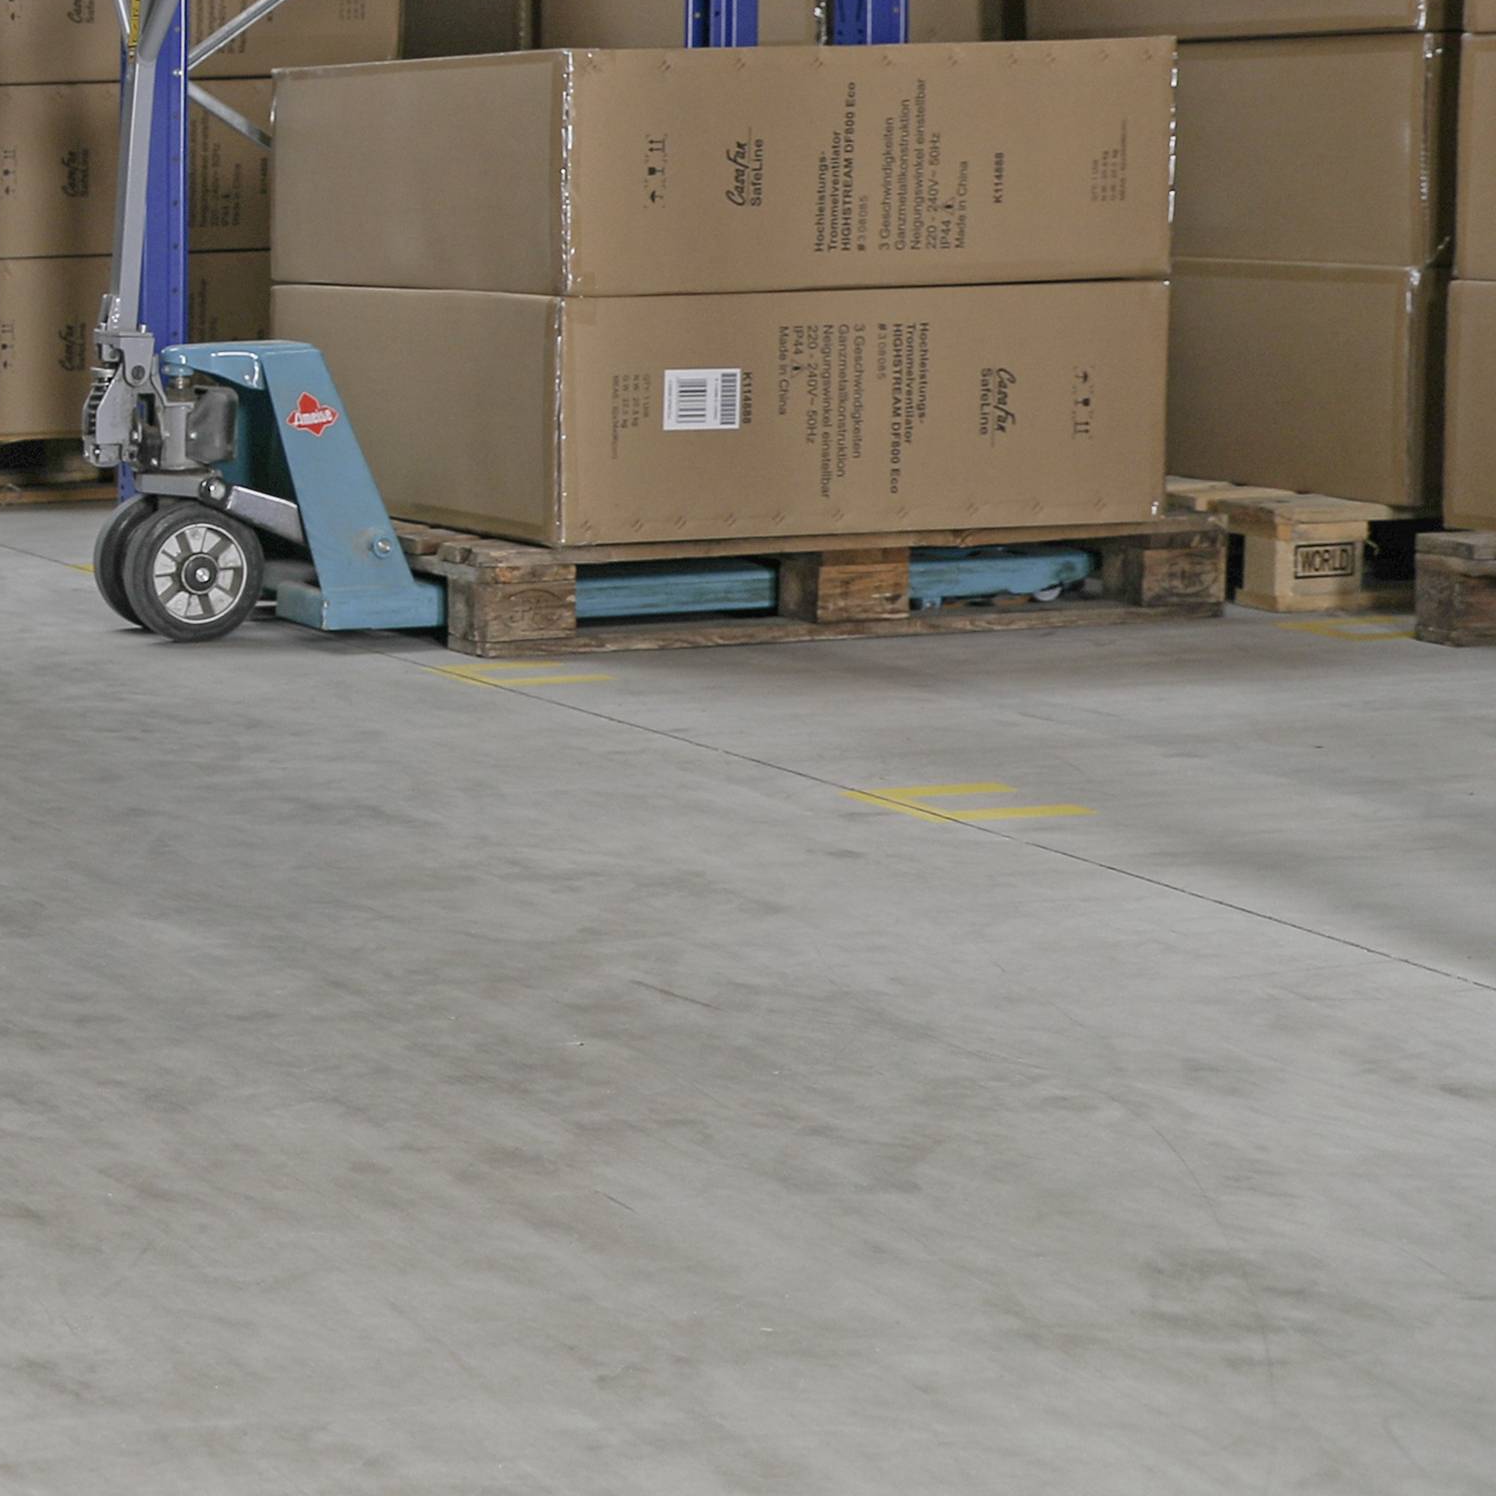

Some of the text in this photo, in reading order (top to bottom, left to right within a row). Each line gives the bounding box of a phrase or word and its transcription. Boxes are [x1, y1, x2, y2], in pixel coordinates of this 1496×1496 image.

[827, 131, 841, 252] Trommelventilator
[841, 82, 856, 251] HIGHSTREAM DF800 Eco
[879, 117, 896, 240] Geschwindigkeiten
[894, 98, 910, 251] Ganzmetallkonstruktion
[910, 78, 926, 251] Neigungswinkel einstellbar
[929, 132, 940, 166] 50Hz
[955, 160, 968, 249] Made in China
[926, 225, 937, 249] 220
[940, 219, 951, 250] IP44
[778, 326, 790, 416] Made in China
[793, 325, 804, 355] IP44
[807, 325, 818, 350] 220
[851, 335, 865, 459] Geschwindigkeiten
[904, 323, 916, 444] Trommelventilator
[806, 409, 818, 444] 50Hz
[820, 324, 834, 499] Neigungswinkel einstellbar
[836, 323, 850, 478] Ganzmetallkonstruktion
[890, 323, 903, 494] HIGHSTREAM DF800 Eco
[1300, 548, 1348, 572] WORLD
